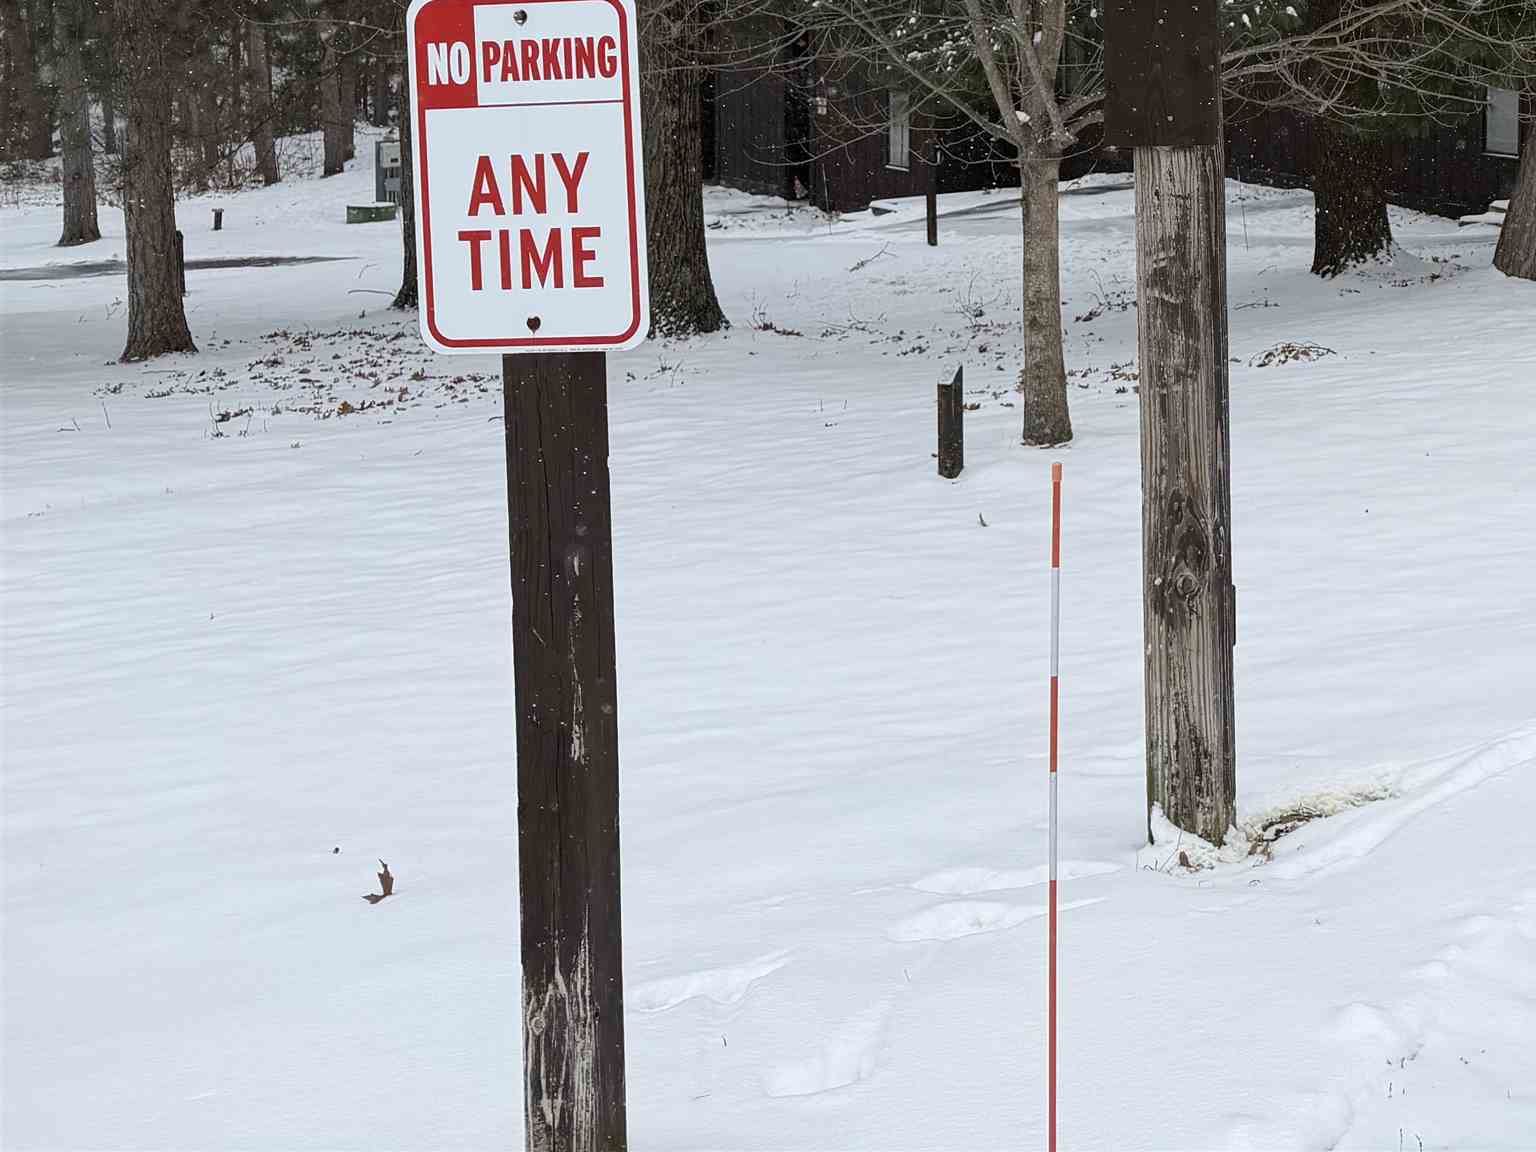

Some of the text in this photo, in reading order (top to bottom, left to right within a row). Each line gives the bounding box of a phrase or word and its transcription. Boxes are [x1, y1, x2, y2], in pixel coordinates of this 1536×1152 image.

[427, 35, 618, 86] NO PARKING
[467, 151, 590, 217] ANY
[457, 226, 605, 291] TIME
